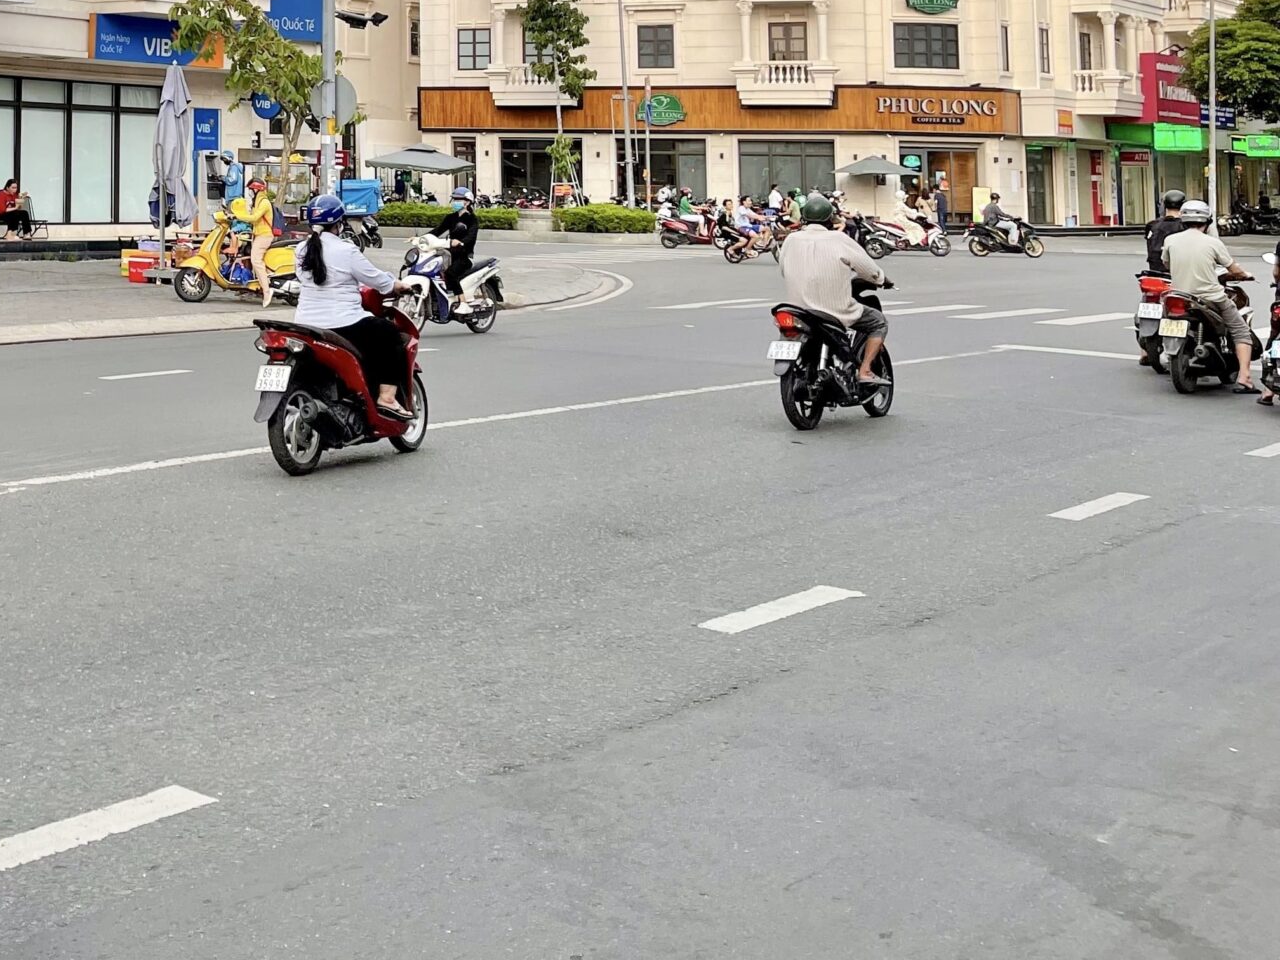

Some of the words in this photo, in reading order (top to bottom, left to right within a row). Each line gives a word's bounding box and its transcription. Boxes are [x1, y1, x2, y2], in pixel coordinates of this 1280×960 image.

[143, 37, 173, 57] VIB
[255, 99, 271, 109] VIB
[877, 96, 936, 114] PHUC
[940, 98, 998, 116] LONG
[196, 123, 211, 133] VIB
